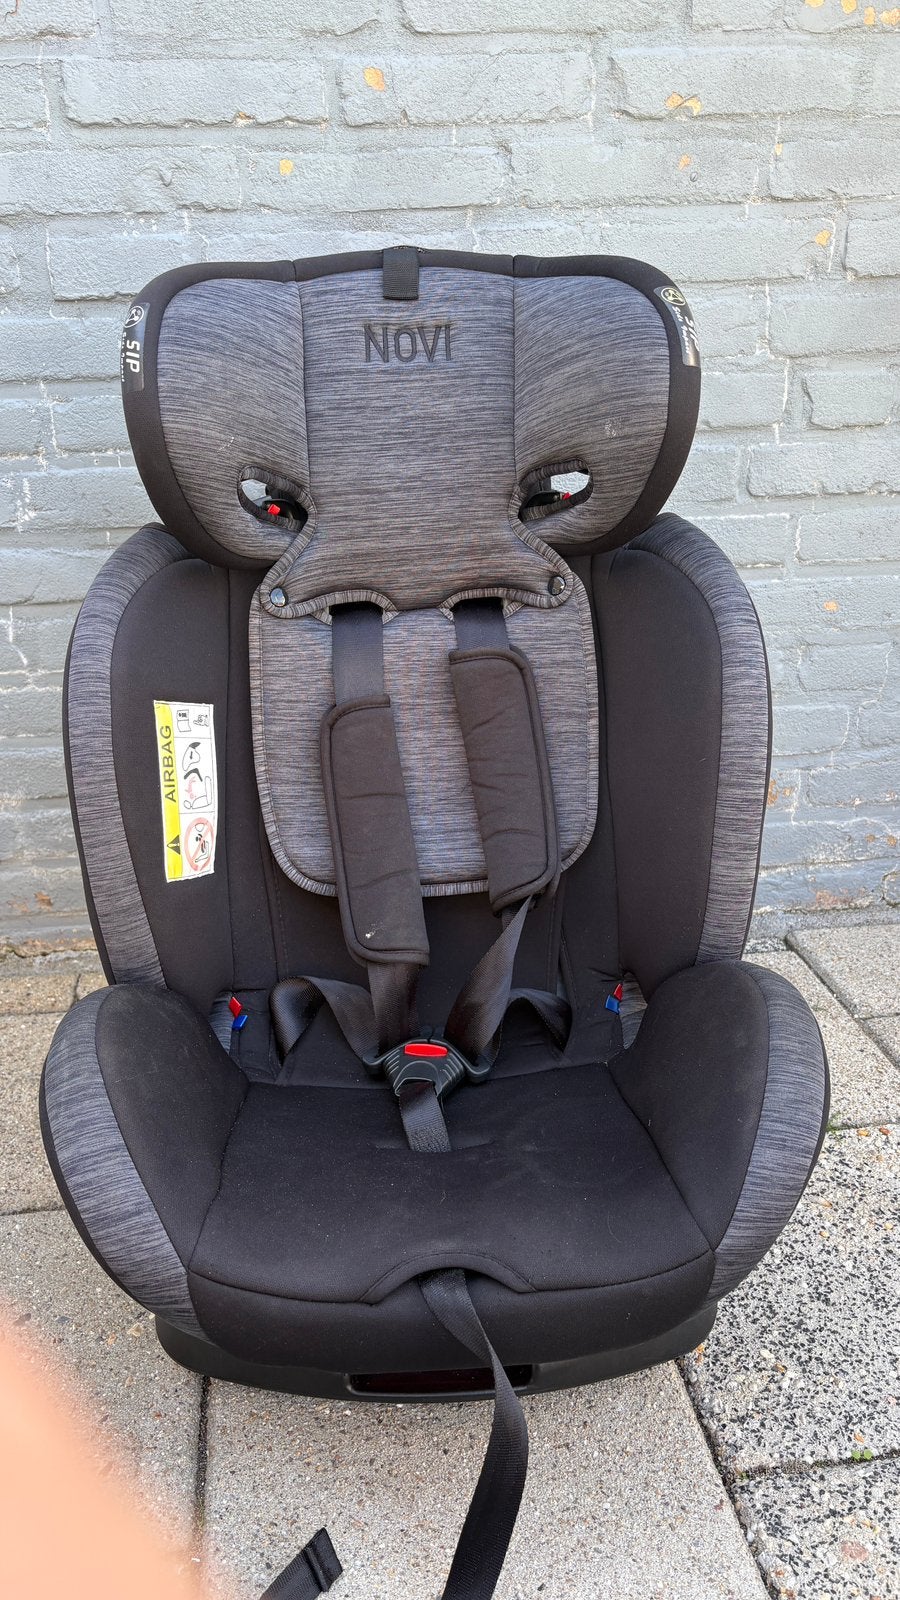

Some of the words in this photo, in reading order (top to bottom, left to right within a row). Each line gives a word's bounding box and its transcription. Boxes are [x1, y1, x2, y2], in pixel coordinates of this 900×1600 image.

[126, 339, 141, 373] SIP
[364, 323, 452, 363] NOVI
[160, 725, 176, 803] AIRBAG
